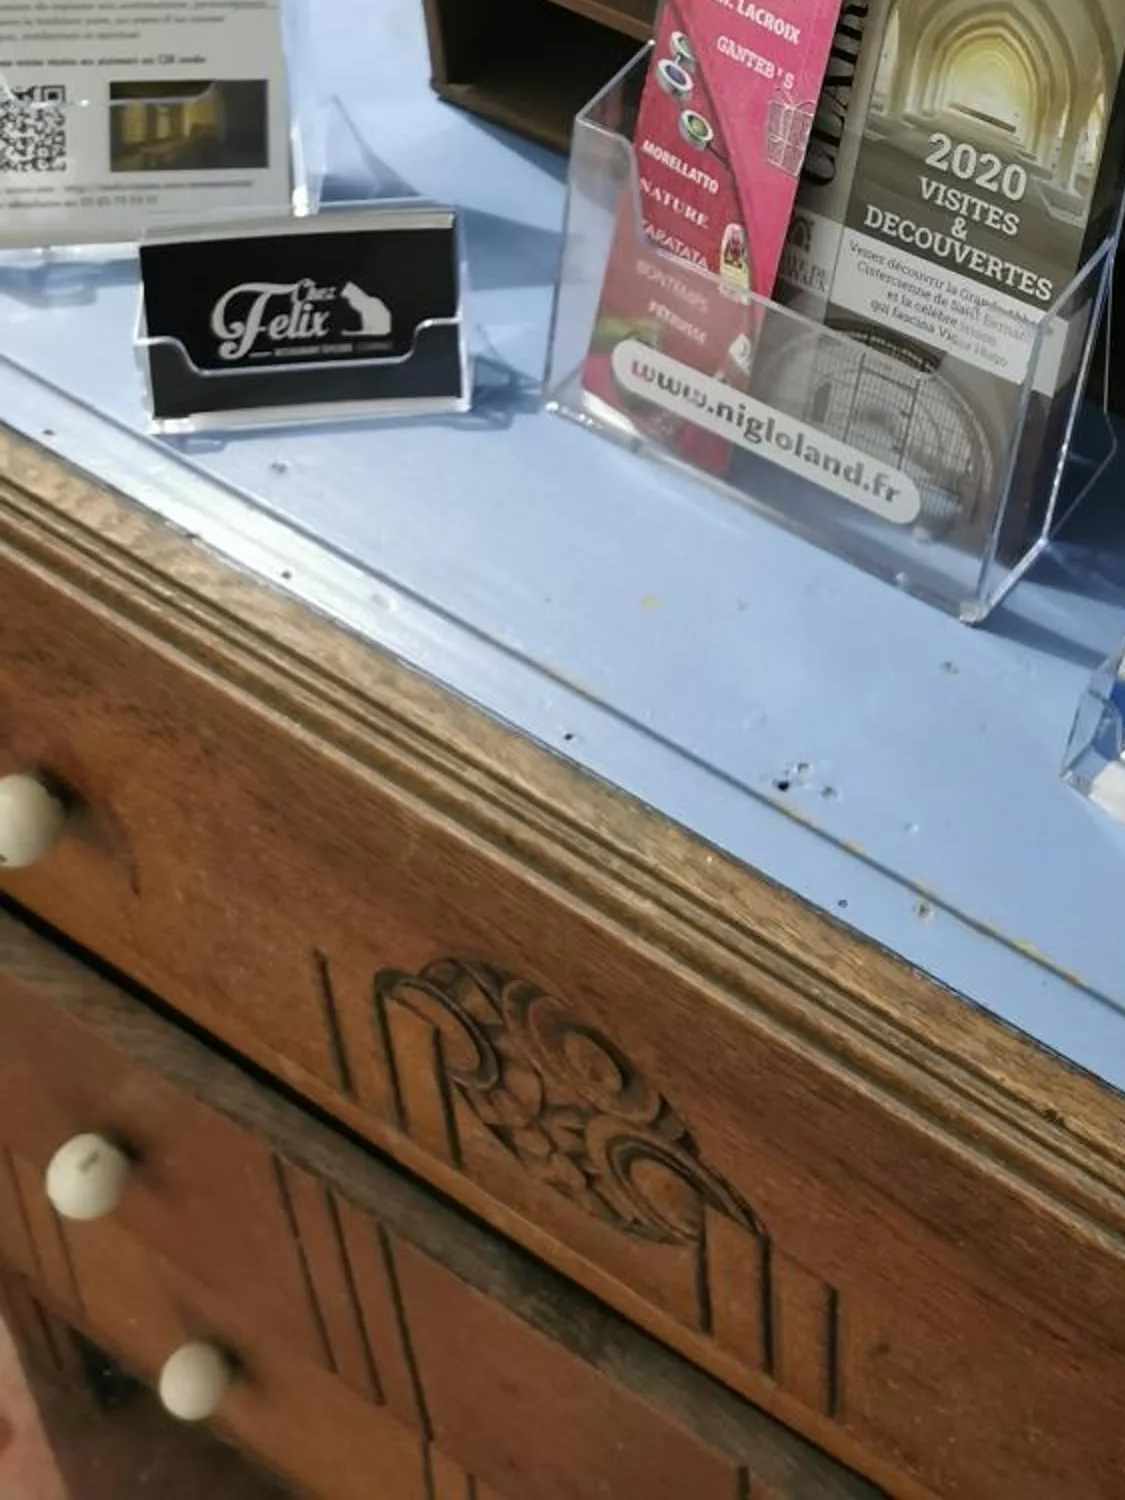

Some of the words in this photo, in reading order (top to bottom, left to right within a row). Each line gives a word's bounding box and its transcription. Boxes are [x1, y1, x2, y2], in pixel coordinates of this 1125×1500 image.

[642, 140, 719, 194] MORELLATTO
[925, 132, 1027, 200] 2020
[919, 177, 1020, 236] VISITES
[951, 216, 968, 239] &
[864, 204, 1053, 301] DECOUVERTES
[887, 259, 945, 289] découvrir
[211, 282, 331, 361] Felix
[631, 358, 902, 504] www.nigloland.fr
